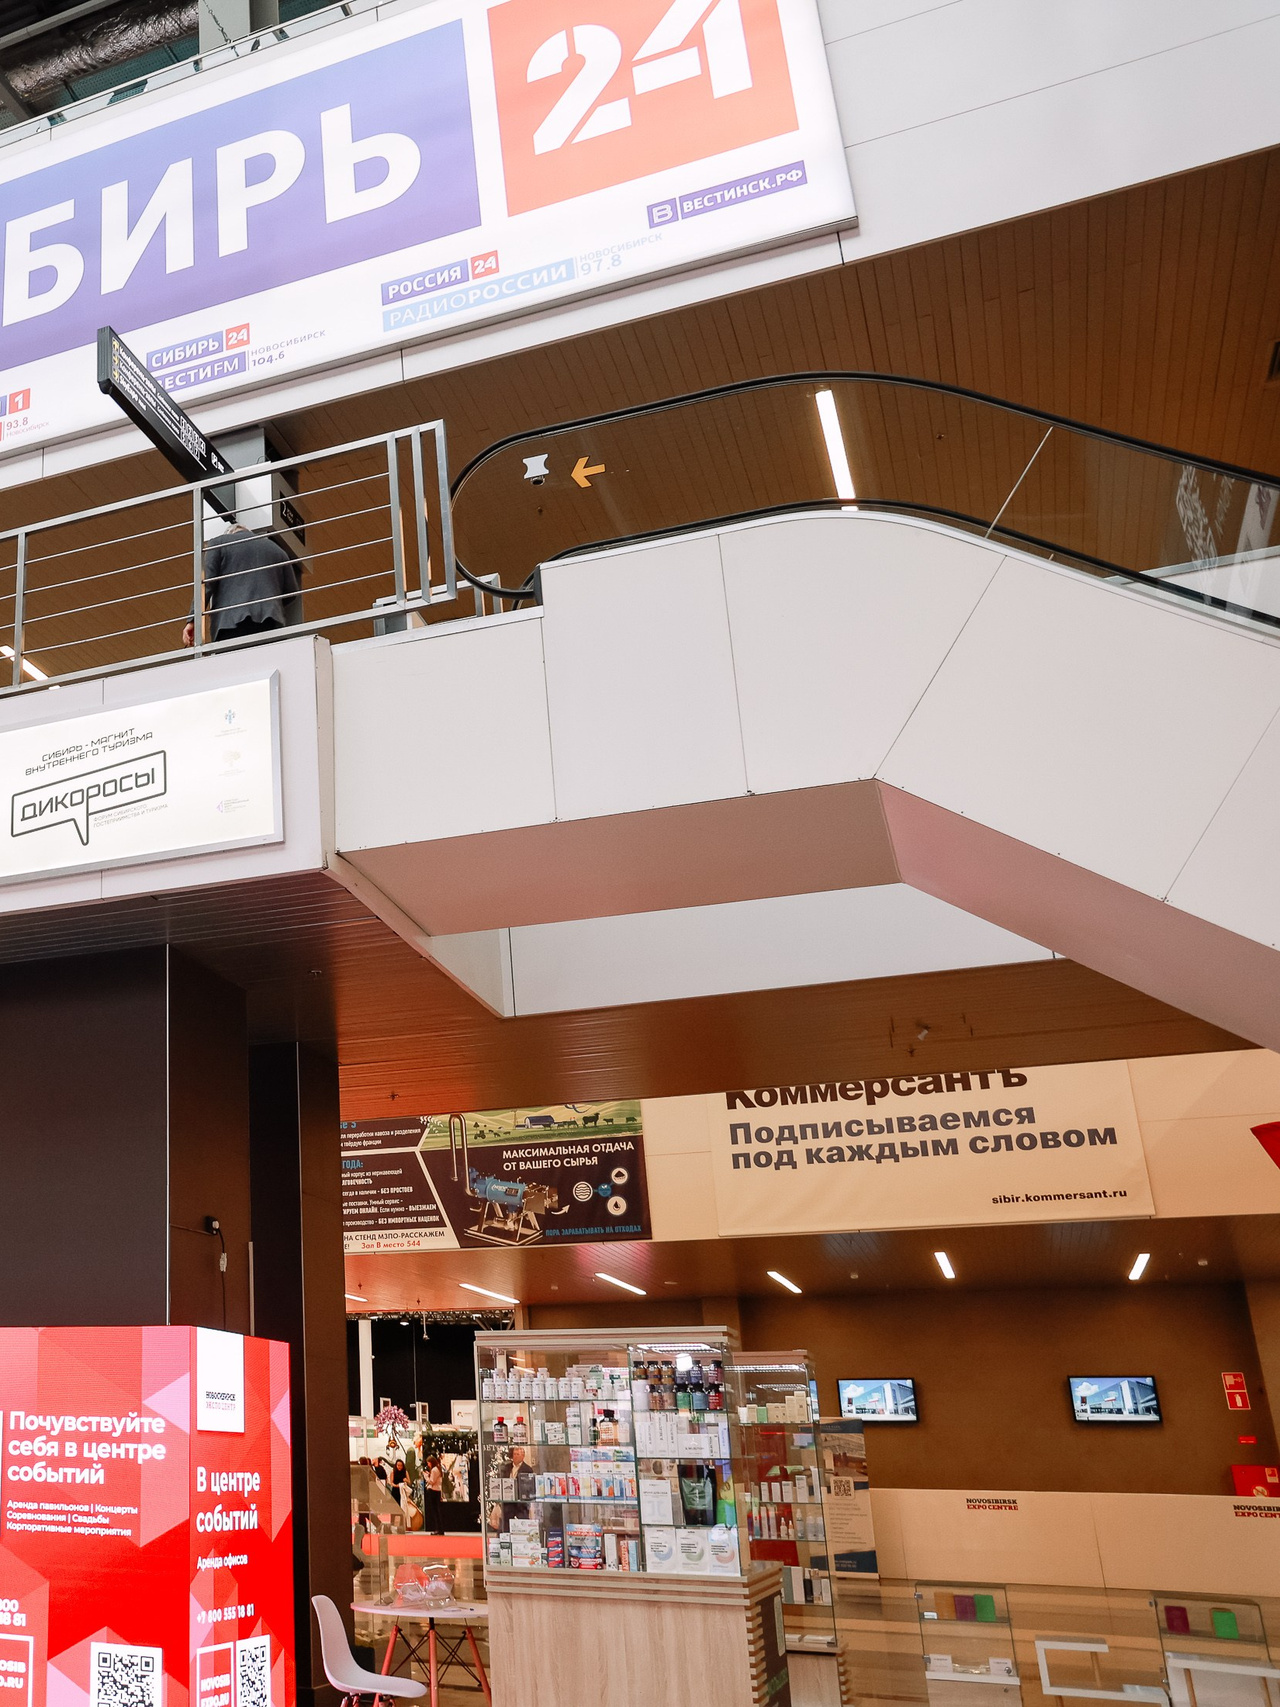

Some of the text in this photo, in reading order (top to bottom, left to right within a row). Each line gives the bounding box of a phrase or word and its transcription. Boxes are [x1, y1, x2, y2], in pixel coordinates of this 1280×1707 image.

[526, 0, 754, 156] 24
[683, 168, 803, 213] ВЕСТИНСК.РФ
[579, 233, 663, 263] НОВОСИБИРСК
[581, 254, 623, 276] 97.8
[388, 255, 497, 299] РОССИЯ 24
[151, 328, 248, 367] СИБИРЬ 24
[250, 330, 326, 357] НОВОСИБИРСК
[252, 351, 286, 367] 104.6
[13, 393, 24, 410] 1
[6, 416, 29, 431] 93.8
[6, 421, 50, 438] Новосибирск
[25, 731, 153, 776] ВНУТРЕННЕГО ТУРИЗМА
[42, 728, 135, 763] СИБИРЬ МАГНИТ
[20, 768, 155, 823] ДИКОРОСЫ
[726, 1067, 1028, 1111] Коммерсантъ
[729, 1106, 1037, 1145] Подписываемся
[503, 1141, 634, 1159] МАКСИМАЛЬНАЯ ОТДАЧА
[731, 1126, 1118, 1171] под каждым словом
[503, 1156, 598, 1171] ОТ ВАШЕГО СЫРЬЯ
[991, 1187, 1128, 1205] sibir.kommersant.ru
[378, 1231, 445, 1240] МЗПО-РАССКАЖЕМ
[9, 1411, 165, 1437] Почувствуйте
[8, 1435, 166, 1464] себя в центре
[7, 1461, 105, 1484] событий
[197, 1466, 260, 1498] В центре
[6, 1511, 109, 1525] Соревнования Свадьбы
[7, 1500, 138, 1515] Аренда павильонов Концерты
[196, 1503, 258, 1533] событий
[6, 1522, 132, 1537] Корпоративные мероприятия
[197, 1553, 248, 1572] Аренда офисов
[12, 1613, 26, 1627] 81
[196, 1603, 254, 1624] +7 800 555 18 81
[200, 1673, 231, 1692] NOVOSIB
